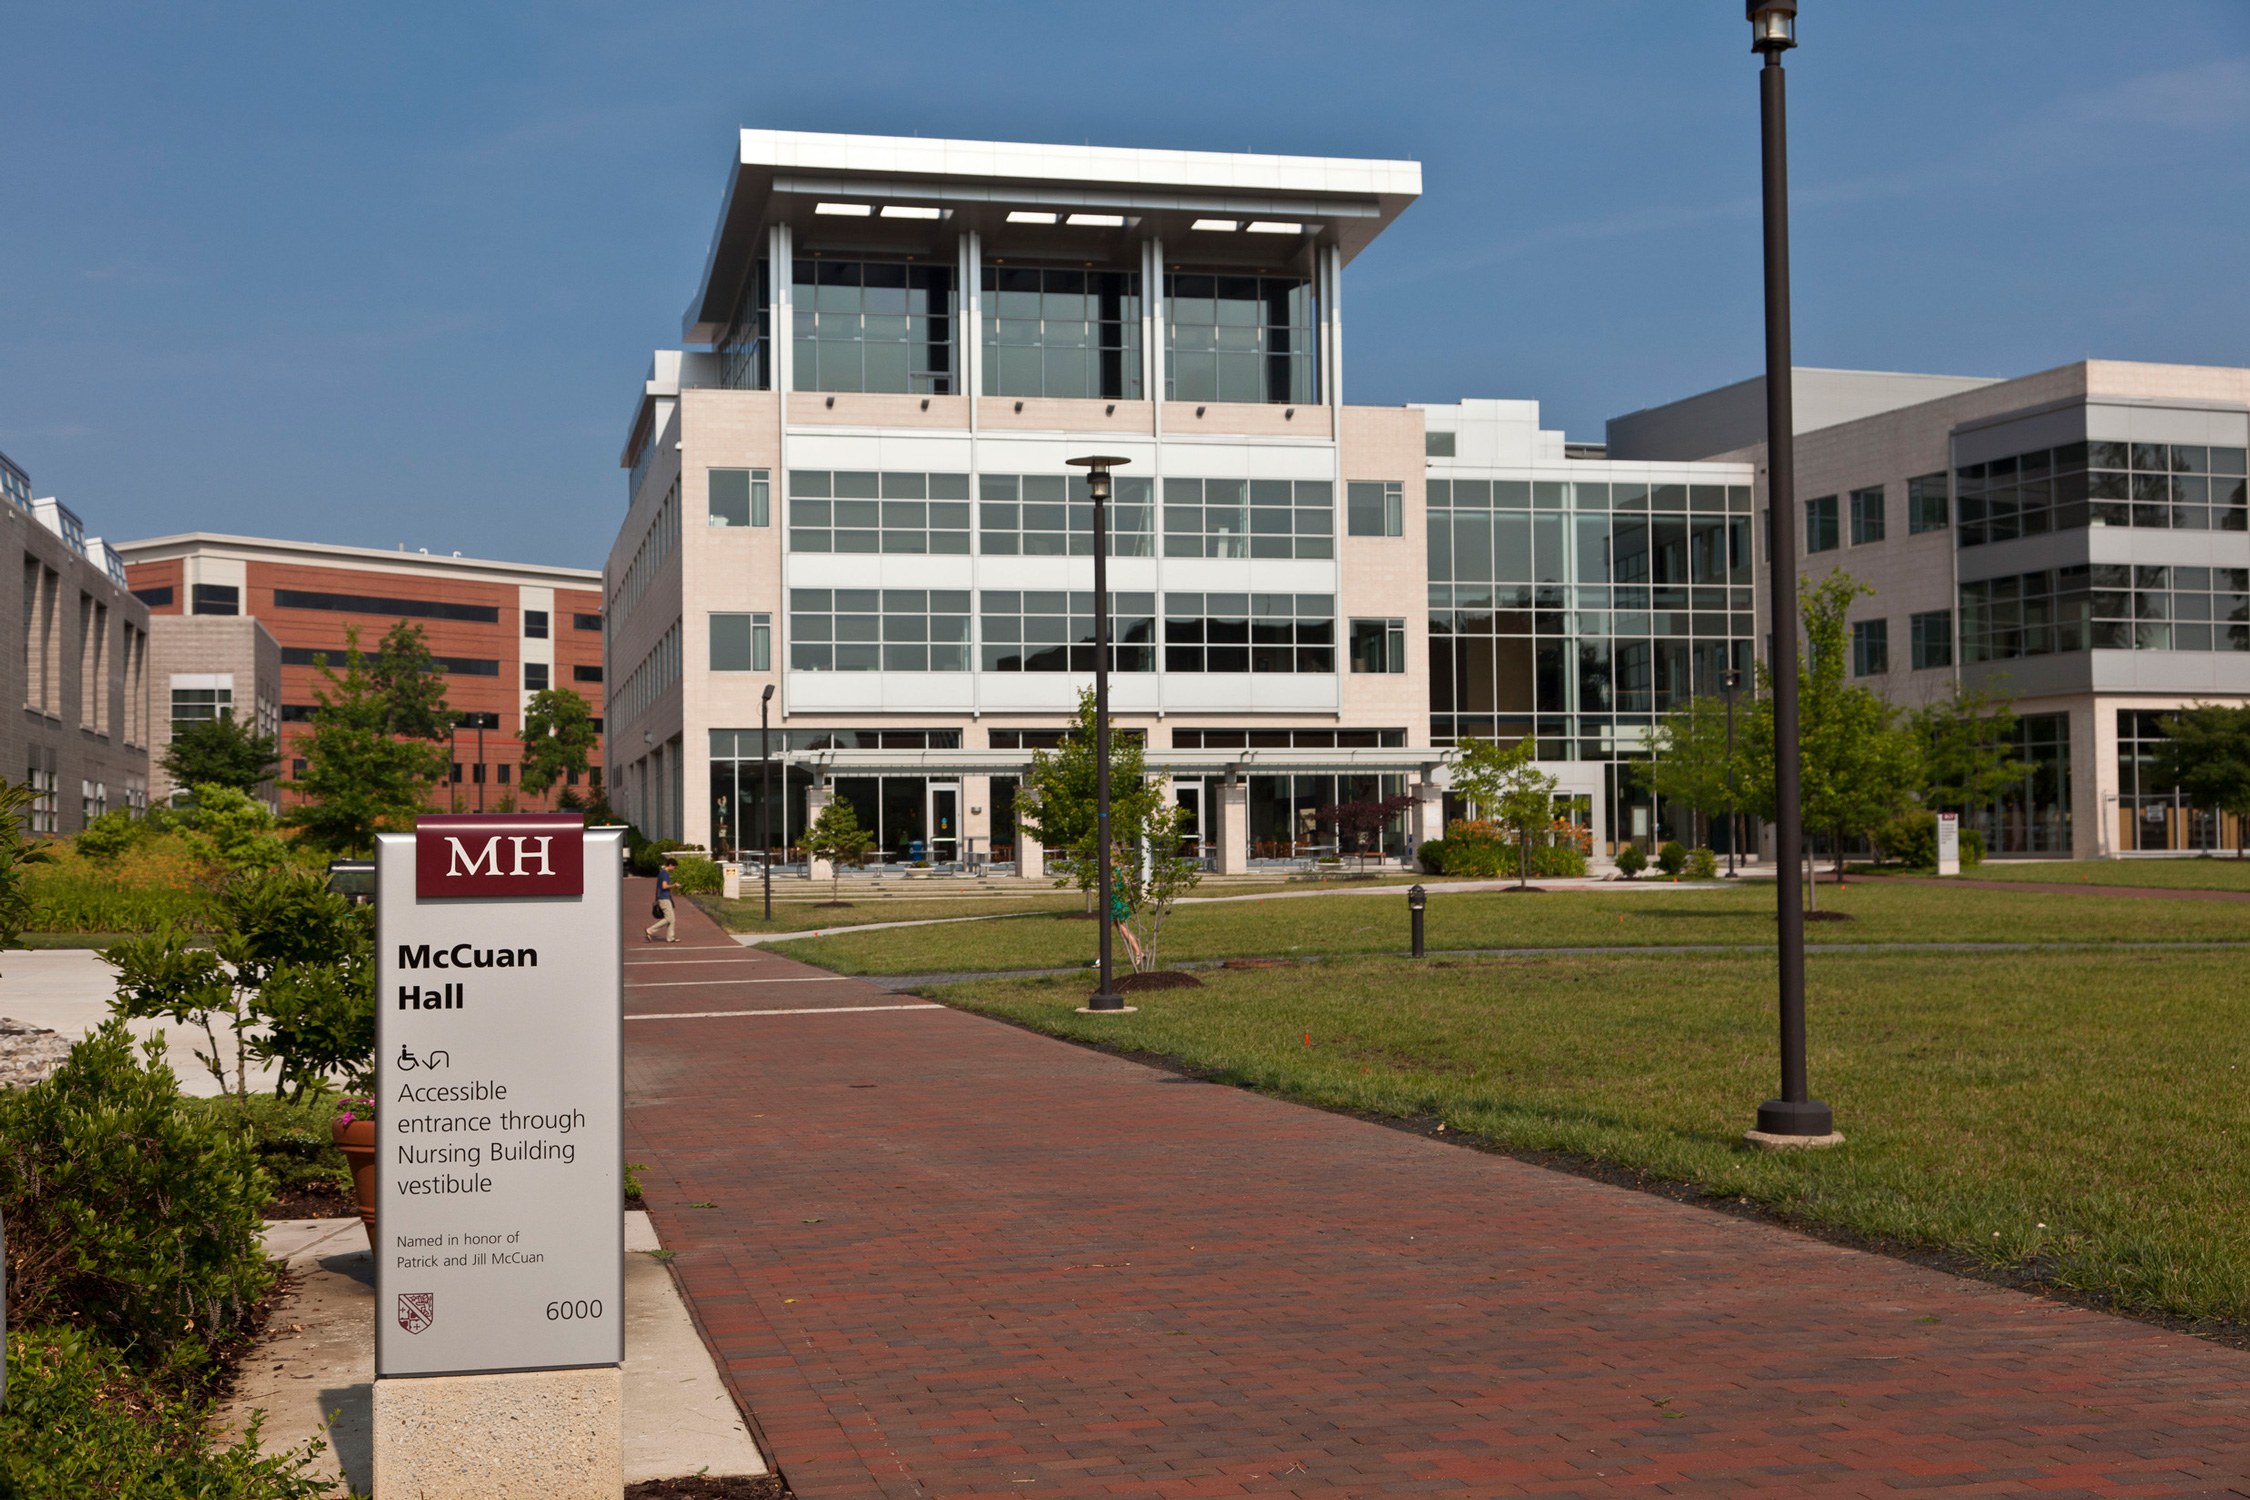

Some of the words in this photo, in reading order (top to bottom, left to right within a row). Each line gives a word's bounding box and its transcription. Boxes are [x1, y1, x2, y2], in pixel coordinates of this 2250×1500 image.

[444, 835, 556, 877] MH
[398, 943, 538, 970] McCuan
[398, 982, 464, 1011] Hall
[397, 1079, 508, 1103] Accessible
[397, 1114, 492, 1134] entrance
[499, 1107, 585, 1134] through
[398, 1142, 481, 1168] Nursing
[490, 1139, 575, 1165] Building
[396, 1172, 493, 1196] vestibule
[396, 1233, 443, 1248] Named
[447, 1233, 459, 1246] in
[464, 1232, 503, 1246] honor
[506, 1230, 520, 1244] of
[397, 1254, 439, 1269] Patrick
[443, 1253, 468, 1267] and
[471, 1252, 487, 1266] Jill
[491, 1251, 544, 1265] McCuan
[546, 1299, 603, 1321] 6000
